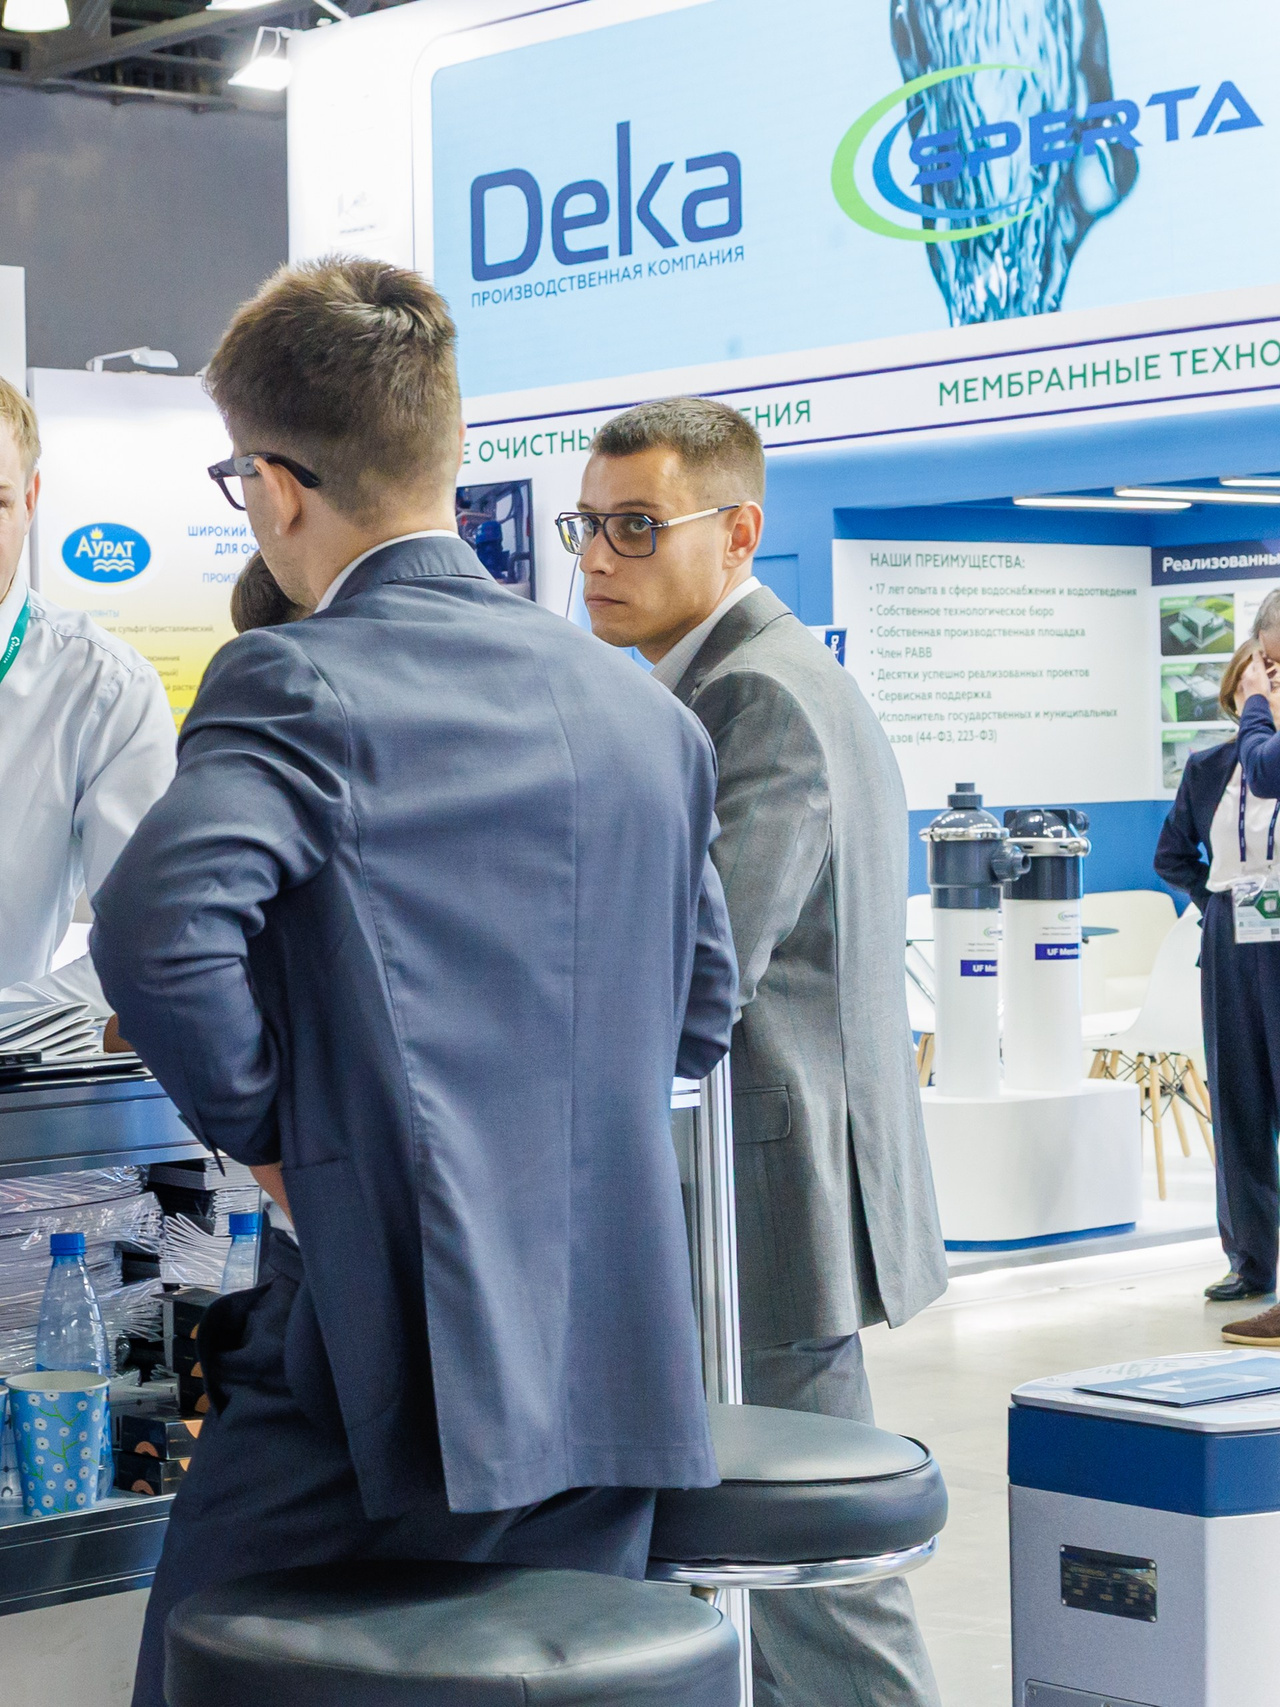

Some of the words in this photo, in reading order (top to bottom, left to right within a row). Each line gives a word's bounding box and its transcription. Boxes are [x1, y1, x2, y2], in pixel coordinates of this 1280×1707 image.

[909, 79, 1265, 187] SPERTA
[470, 120, 742, 282] Deka
[471, 263, 643, 308] ПРОИЗВОДСТВЕННАЯ
[647, 245, 745, 277] КОМПАНИЯ
[938, 355, 1161, 406] МЕМБРАННЫЕ
[187, 523, 247, 537] ШИРОКИЙ
[214, 542, 238, 556] ДЛЯ
[870, 553, 912, 567] НАШИ
[915, 553, 1026, 570] ПРЕИМУЩЕСТВА:
[875, 583, 886, 595] 17
[888, 586, 905, 595] лет
[907, 586, 938, 596] опыта
[941, 586, 946, 595] в
[948, 584, 979, 597] сфере
[981, 584, 1056, 597] водоснабжения
[1067, 587, 1137, 597] водоотведения
[876, 604, 941, 616] Собственное
[943, 606, 1027, 617] технологическое
[1029, 605, 1055, 618] бюро
[876, 626, 941, 638] Собственная
[943, 627, 1035, 639] производственная
[1038, 628, 1086, 638] площадка
[877, 647, 902, 659] Член
[905, 646, 933, 658] РАВВ
[877, 668, 919, 681] Десятки
[922, 670, 965, 682] успешно
[968, 669, 1044, 681] реализованных
[1046, 668, 1090, 680] проектов
[878, 689, 933, 704] Сервисная
[935, 690, 992, 702] поддержка
[879, 711, 945, 722] Исполнитель
[948, 709, 1032, 723] государственных
[1034, 711, 1041, 719] и
[1043, 708, 1118, 721] муниципальных
[888, 734, 914, 743] азов
